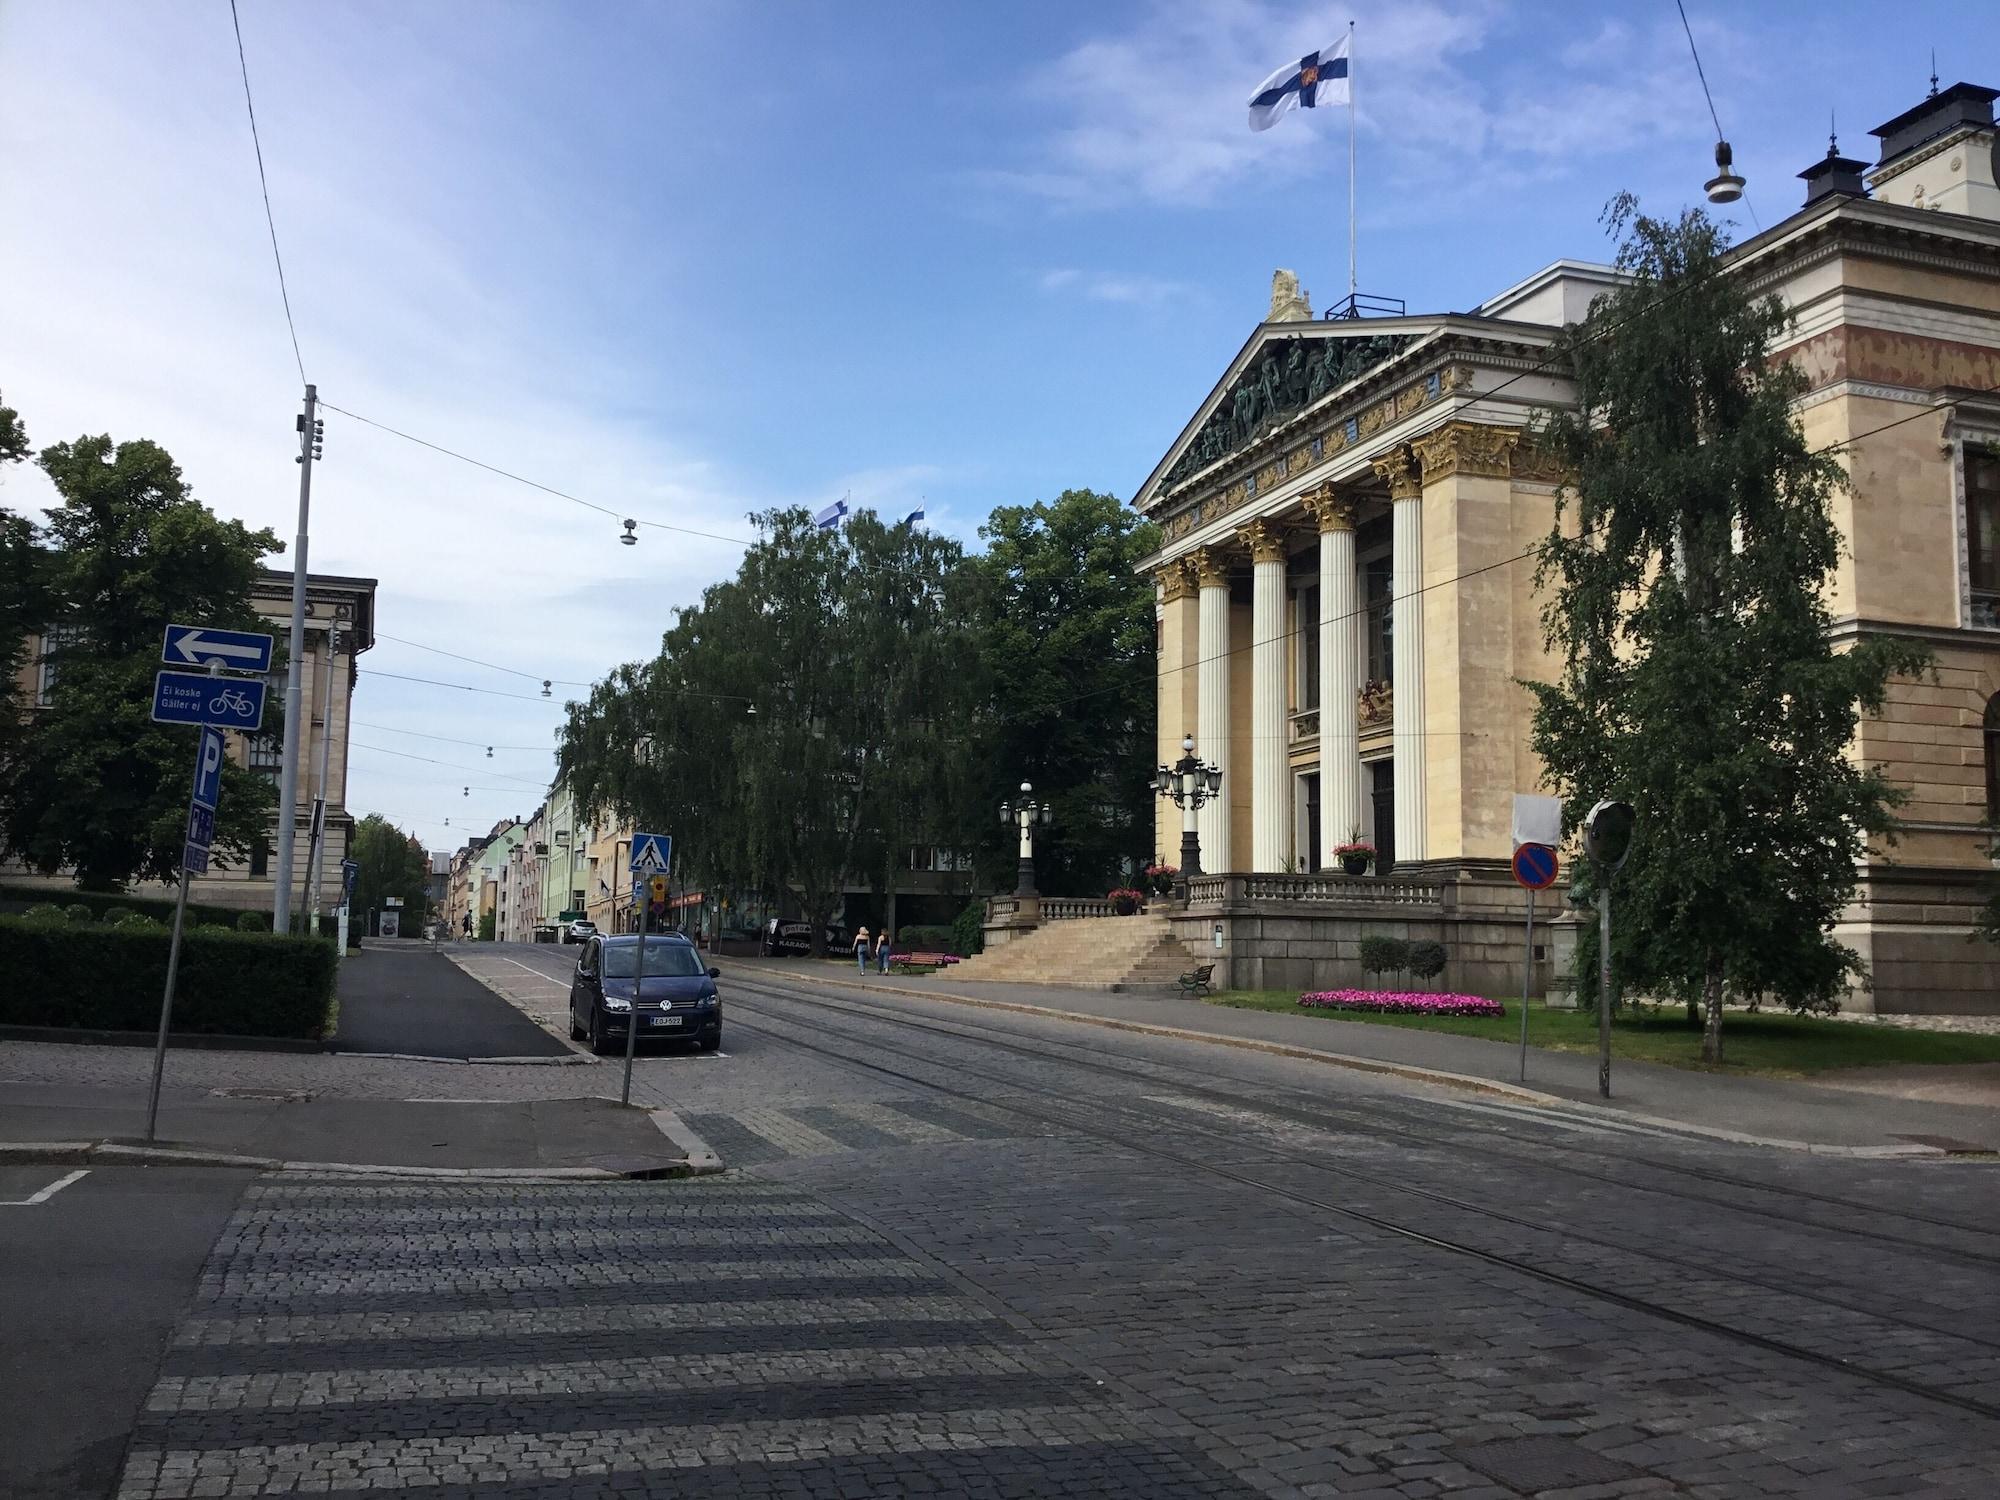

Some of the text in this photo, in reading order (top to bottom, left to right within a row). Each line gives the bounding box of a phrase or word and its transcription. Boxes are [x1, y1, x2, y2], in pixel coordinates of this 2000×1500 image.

[162, 685, 201, 698] Ei koske
[161, 698, 201, 711] Gäller ej
[198, 732, 220, 796] P
[778, 940, 811, 949] KARAOK
